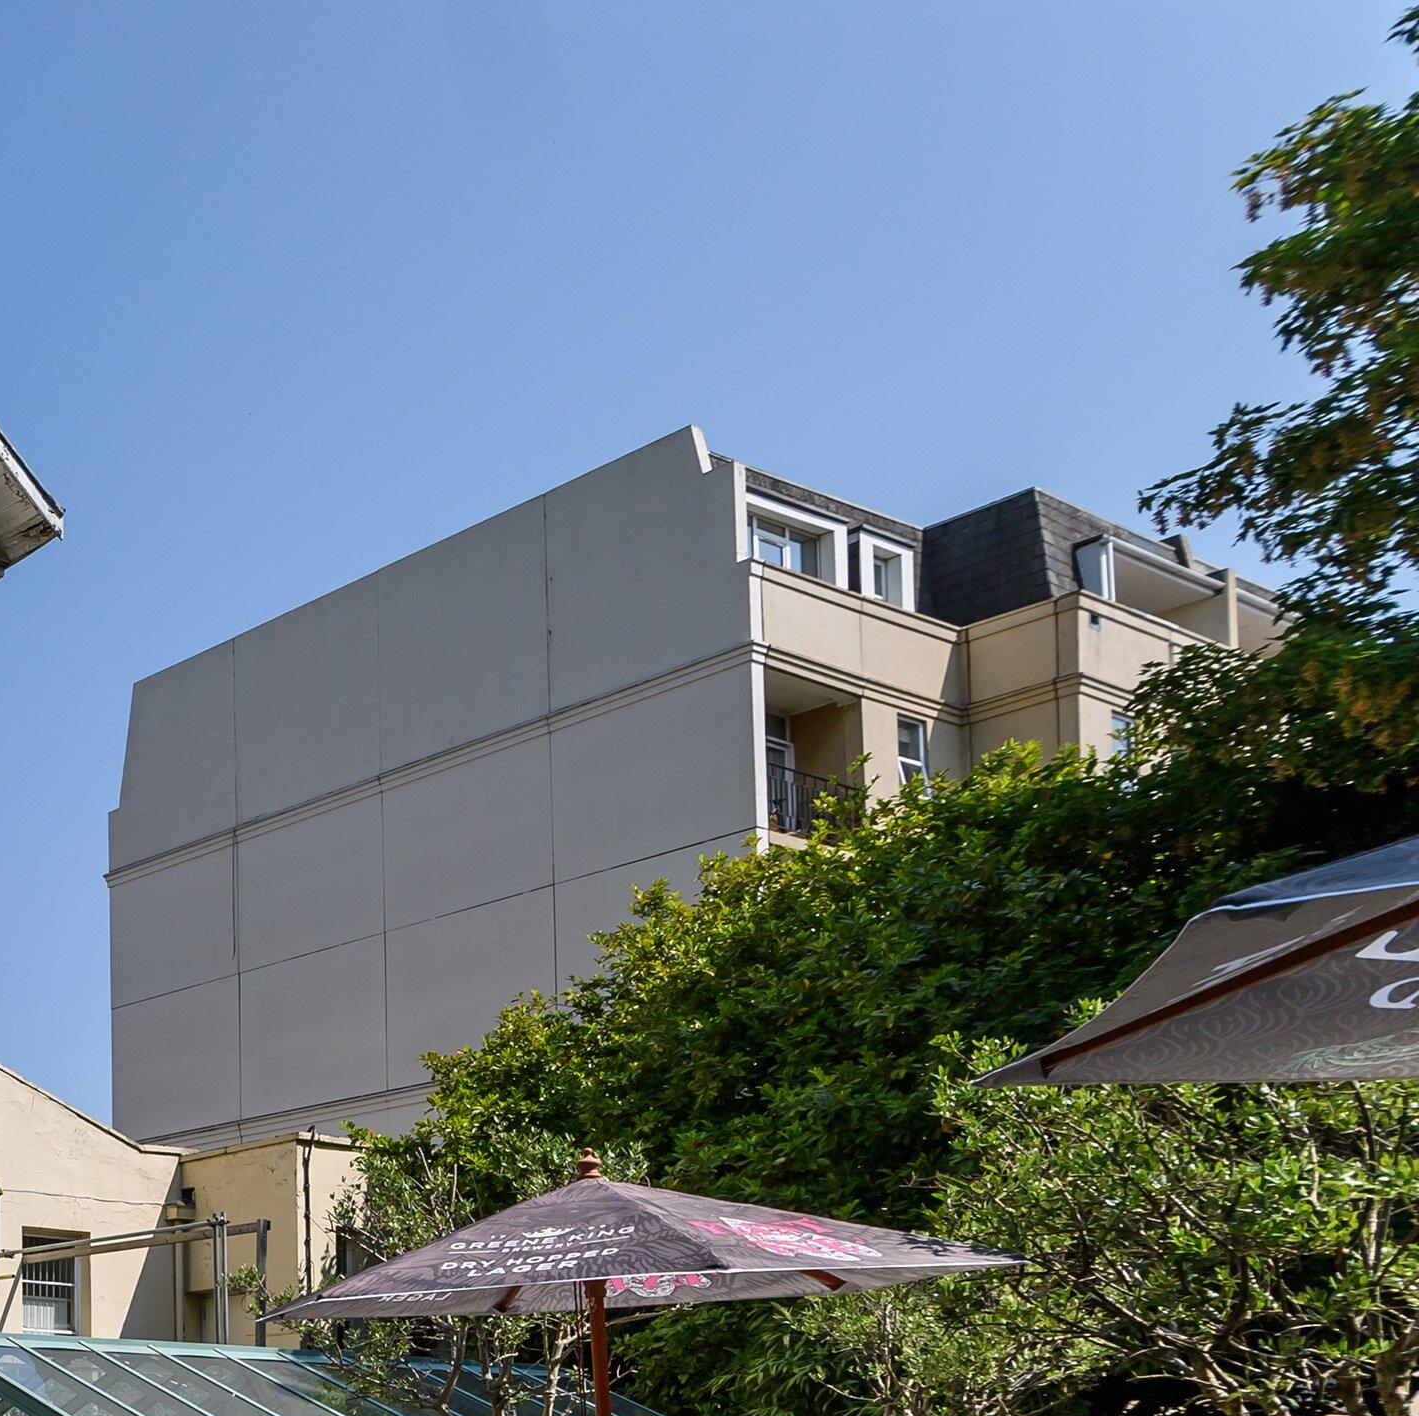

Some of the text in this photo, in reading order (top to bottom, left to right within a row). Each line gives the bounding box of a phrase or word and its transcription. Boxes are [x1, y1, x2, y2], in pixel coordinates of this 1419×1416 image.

[449, 1226, 635, 1250] GREENE KING
[501, 1242, 574, 1253] BREWERY
[441, 1247, 619, 1270] DRY HOPPED
[467, 1260, 578, 1277] LAGER
